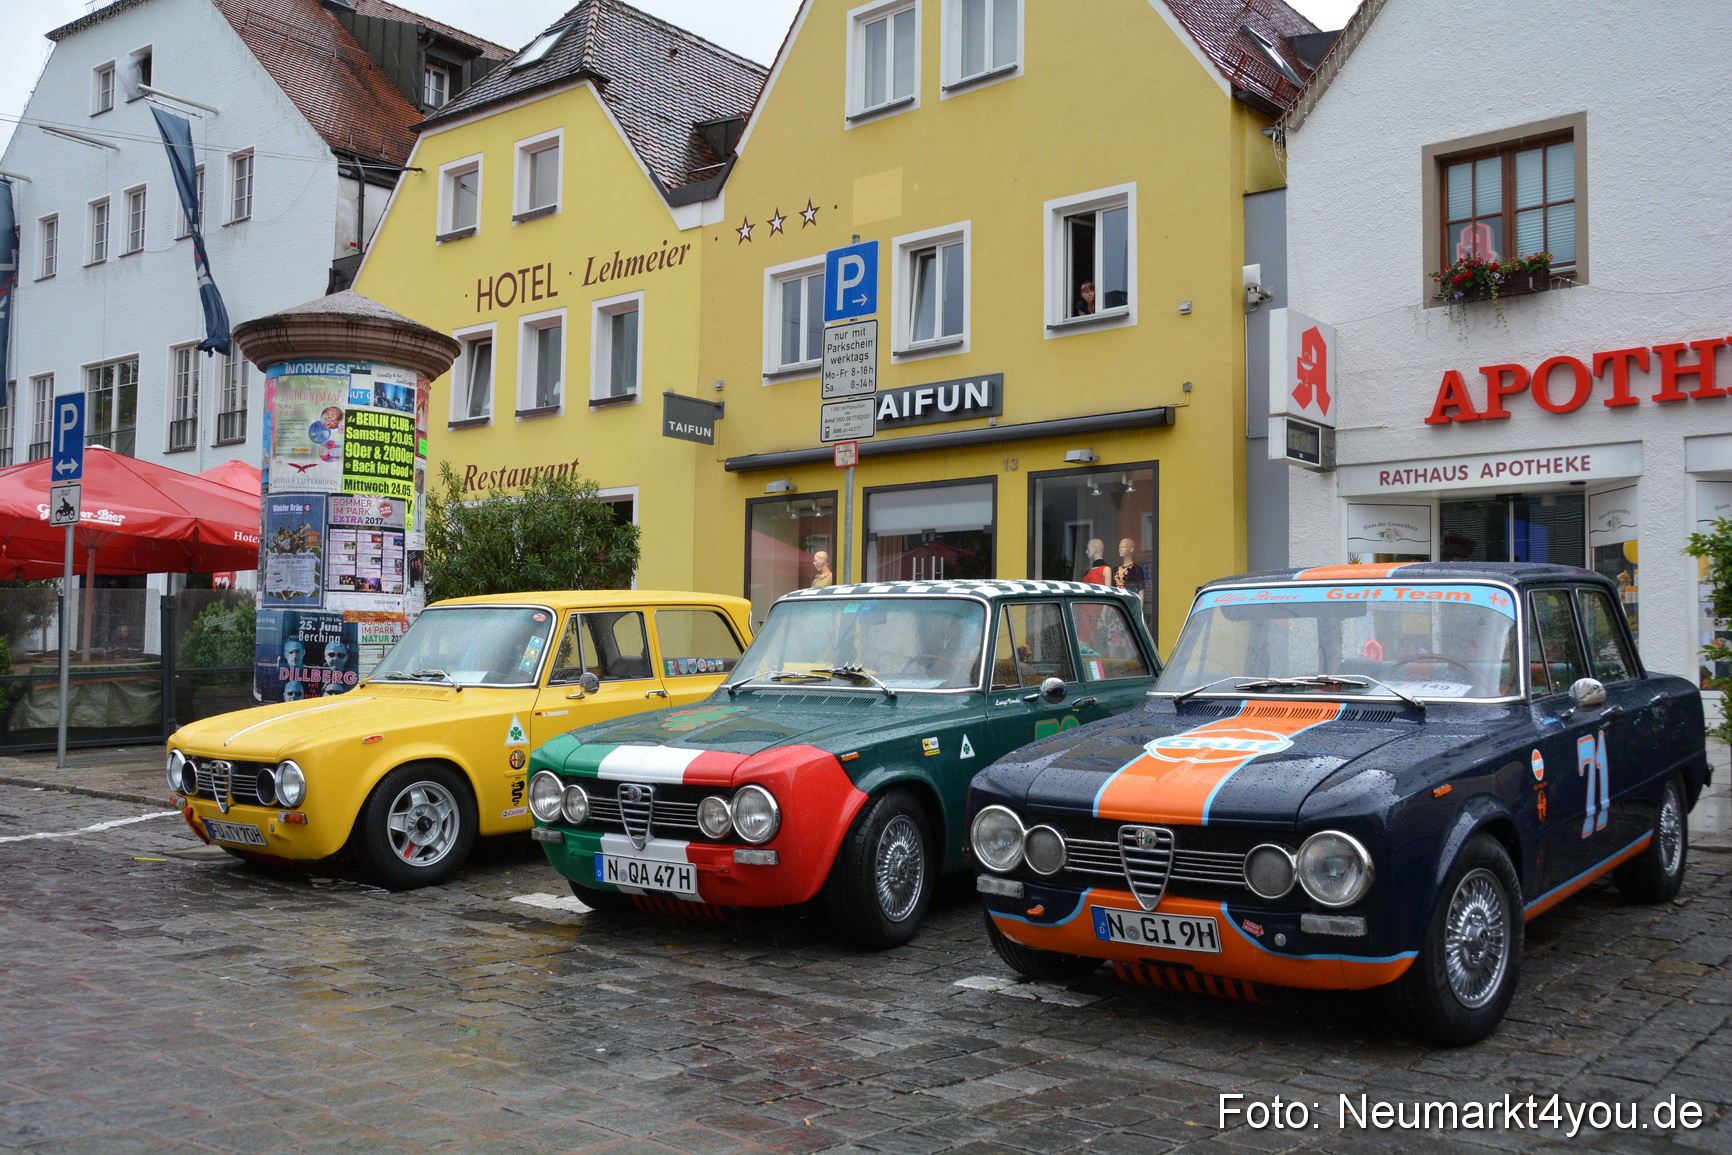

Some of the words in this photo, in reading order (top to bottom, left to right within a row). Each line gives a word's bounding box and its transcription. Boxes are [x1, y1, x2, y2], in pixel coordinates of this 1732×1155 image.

[476, 262, 559, 313] HOTEL
[582, 239, 691, 287] Lehmeier
[836, 254, 866, 311] P
[834, 331, 848, 341] nur
[852, 327, 866, 338] mit
[827, 338, 873, 353] Parkschein
[830, 352, 869, 364] werktags
[825, 368, 848, 380] Mo-Fr
[1424, 336, 1732, 425] APOTH
[825, 383, 834, 392] Sa
[877, 380, 989, 420] AIFUN
[59, 403, 79, 453] P
[356, 412, 389, 428] BERLIN
[390, 416, 410, 432] CLUB
[668, 420, 712, 438] TAIFUN
[346, 426, 390, 444] Samstag
[392, 431, 414, 447] 20.05.
[345, 441, 372, 458] 90er
[374, 446, 382, 460] &
[383, 445, 414, 464] 2000er
[352, 459, 376, 474] Back
[377, 461, 390, 475] for
[391, 463, 409, 478] Good
[1002, 457, 1019, 472] 13
[1379, 464, 1469, 487] RATHAUS
[1480, 455, 1591, 479] APOTHEKE
[462, 457, 580, 494] Restaurant
[344, 479, 390, 494] Mittwoch
[391, 482, 413, 497] 24.05.
[333, 498, 372, 507] SOMMER
[333, 506, 344, 515] IM
[346, 507, 371, 516] PARK
[333, 515, 363, 524] EXTRA
[365, 517, 384, 525] 2017
[1387, 521, 1418, 531] Gesundheit
[1249, 590, 1301, 601] Romeo
[1326, 588, 1383, 600] Gulf
[1392, 587, 1472, 602] Team
[299, 620, 316, 631] 25.
[319, 621, 342, 633] Juni
[374, 626, 395, 634] PARK
[298, 631, 341, 646] Berching
[361, 635, 390, 643] NATUR
[280, 665, 357, 685] DILLBERG
[1422, 683, 1450, 691] 149
[1576, 729, 1610, 839] 71
[608, 858, 619, 881] N
[1105, 912, 1126, 939] N
